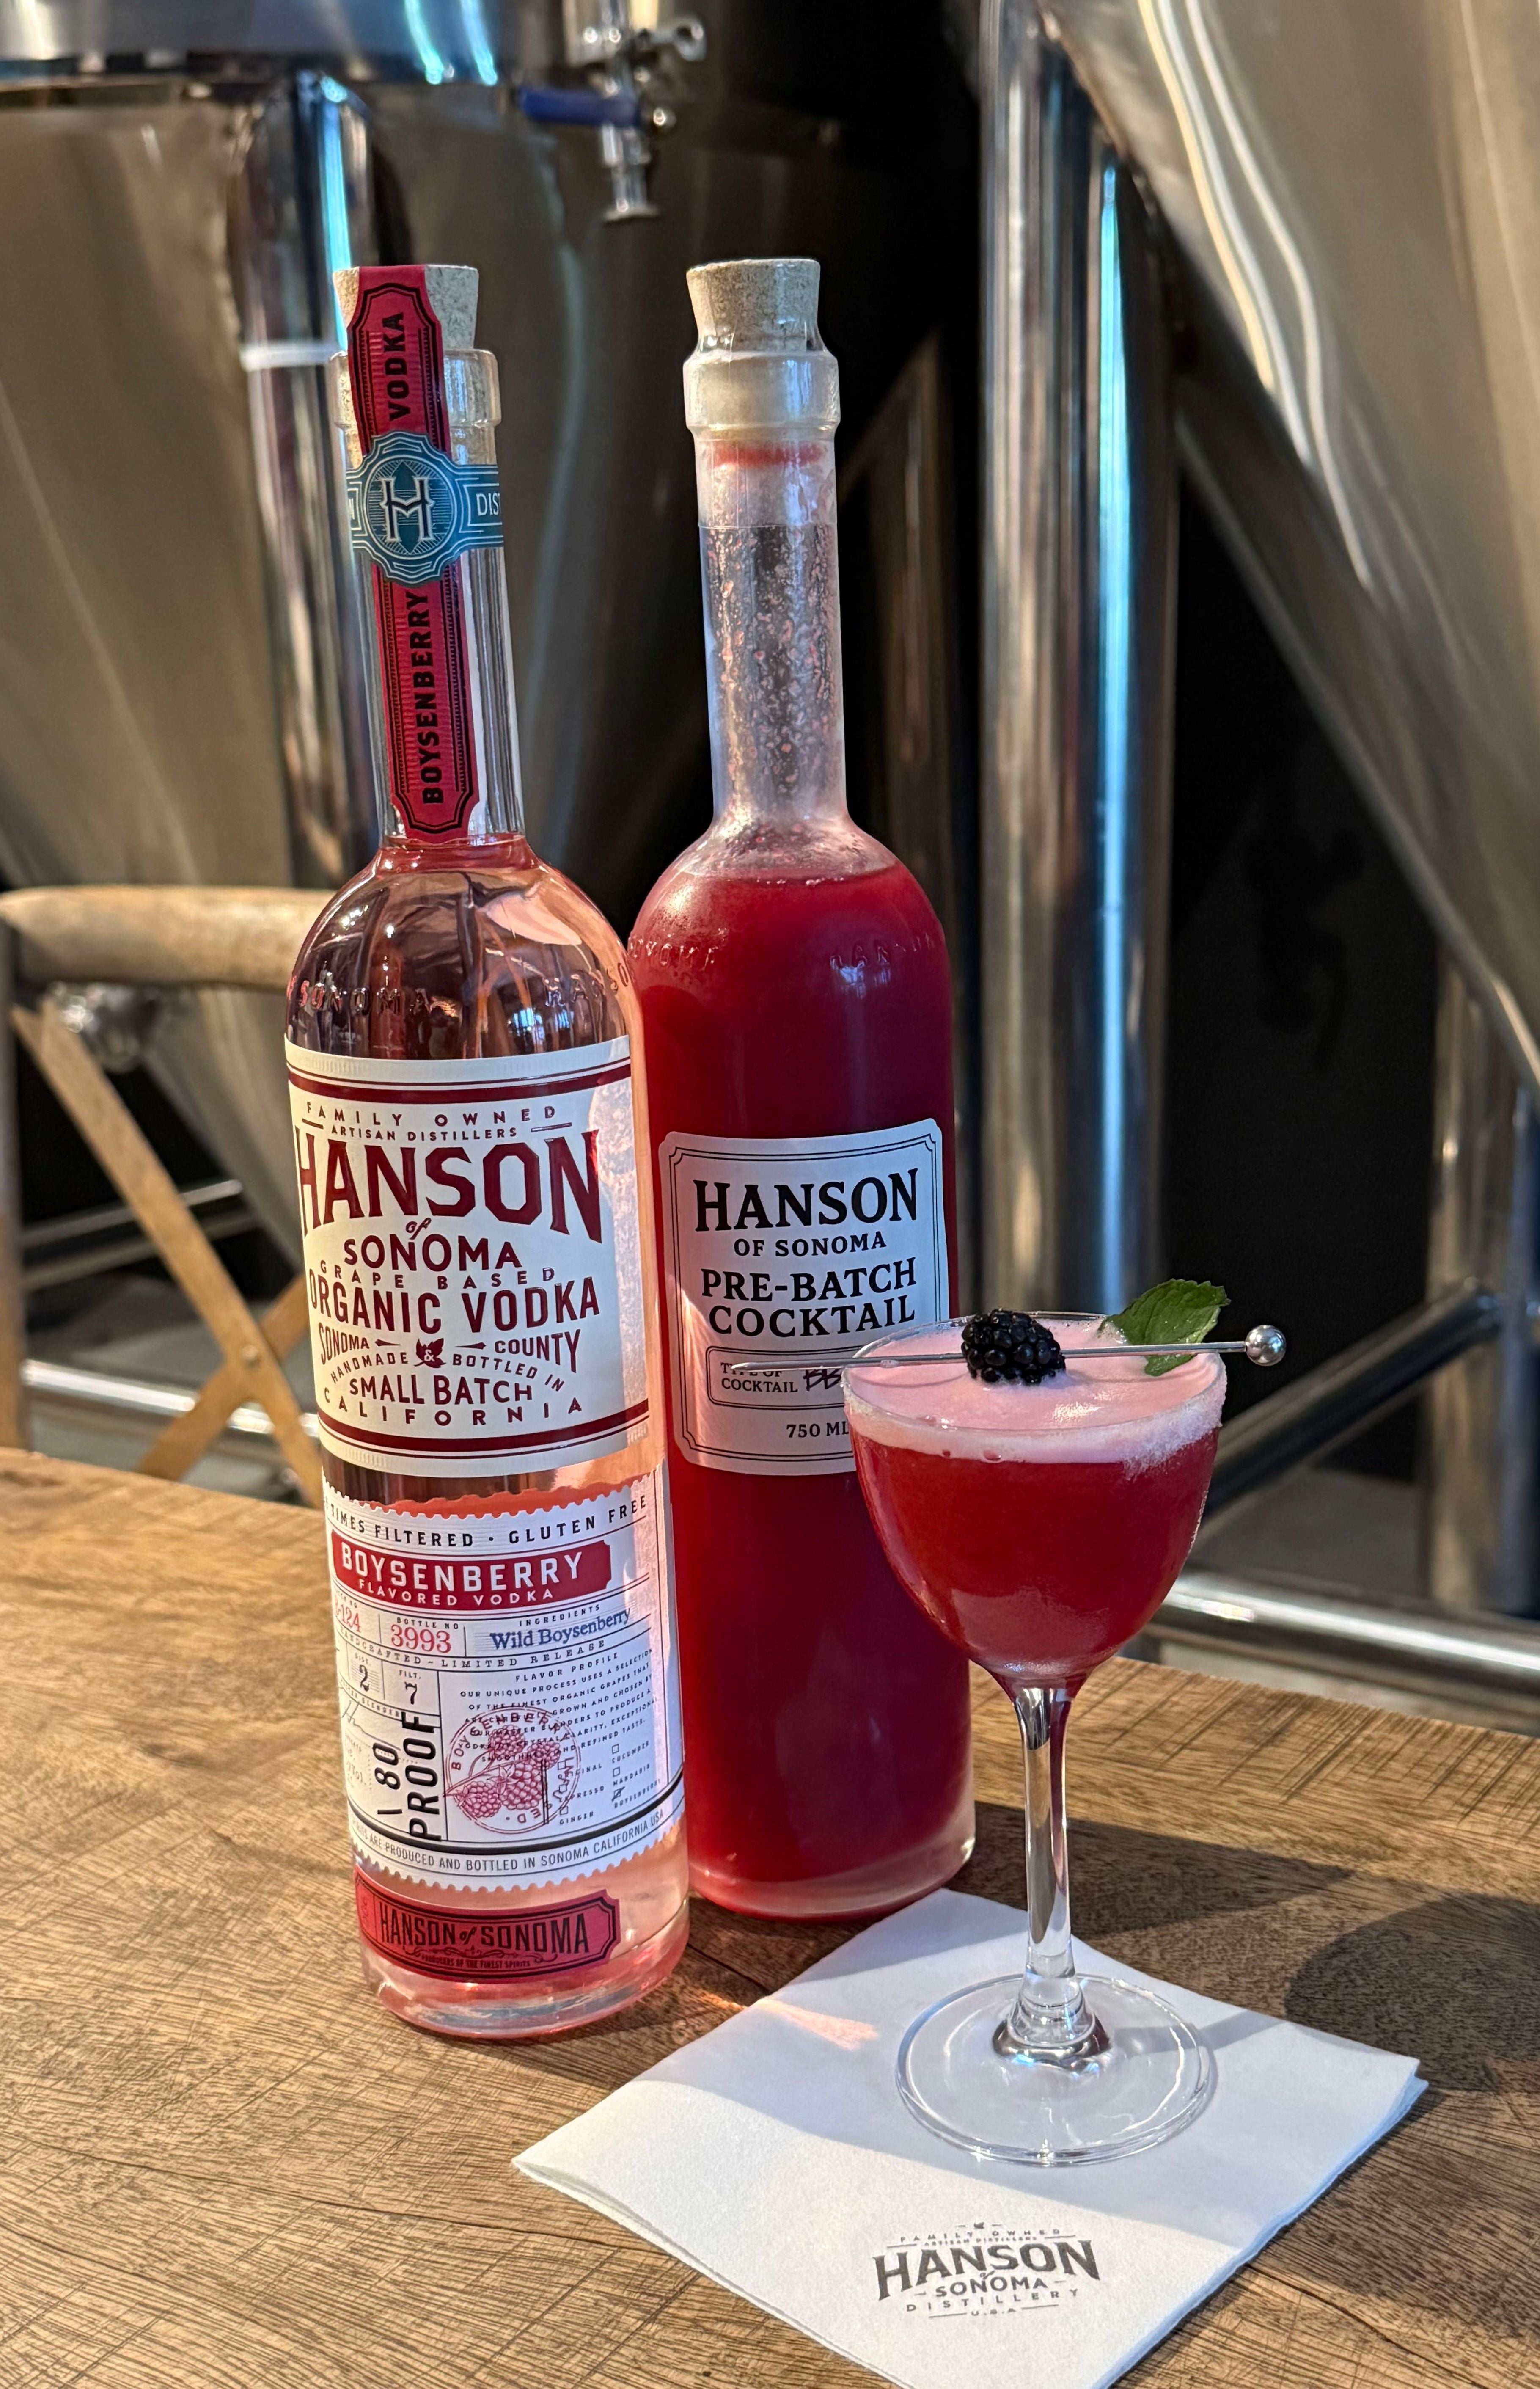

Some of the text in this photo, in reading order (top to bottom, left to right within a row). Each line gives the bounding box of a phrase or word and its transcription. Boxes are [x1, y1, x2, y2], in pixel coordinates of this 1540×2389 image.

[382, 312, 411, 422] VODKA
[476, 493, 500, 516] DIS
[406, 591, 444, 804] BOYSENBERRY
[307, 1102, 556, 1127] FAMILY OWNED
[331, 1125, 518, 1141] ARTISAN DISTILLERS
[295, 1126, 602, 1243] HANSON
[692, 1167, 918, 1232] HANSON
[406, 1217, 432, 1240] of
[344, 1234, 522, 1271] SONOMA
[734, 1231, 887, 1257] OF SONOMA
[320, 1259, 555, 1290] GRAPE BASED
[700, 1256, 917, 1302] PRE-BATCH
[309, 1268, 600, 1334] ORGANIC VODKA
[708, 1294, 916, 1338] COCKTAIL
[319, 1322, 581, 1373] SONOMA COUNTY
[331, 1352, 408, 1384] HANDMADE
[453, 1354, 538, 1379] BOTTLED
[544, 1374, 565, 1392] IN
[721, 1378, 798, 1393] COCKTAIL
[349, 1375, 533, 1405] SMALL BATCH
[324, 1387, 582, 1426] CALIFORNIA
[786, 1424, 821, 1438] 750
[331, 1495, 646, 1547] TIMES FILTERED GLUTEN FREE
[341, 1541, 582, 1592] BOYSENBERRY
[359, 1578, 457, 1606] FLAVORED
[473, 1591, 553, 1606] VODKA
[397, 1617, 437, 1628] BOTTLE
[490, 1607, 631, 1650] Wild Boysenberry
[519, 1604, 600, 1627] INGREDIENTS
[390, 1624, 452, 1653] 3993
[441, 1658, 517, 1668] LIMITED
[530, 1640, 605, 1664] RELEASE
[516, 1652, 618, 1682] FLAVOR PROFILE
[359, 1664, 370, 1692] 2
[404, 1681, 418, 1705] 7
[487, 1688, 526, 1697] UNIQUE
[532, 1679, 577, 1693] PROCESS
[581, 1672, 603, 1683] USES
[553, 1687, 596, 1703] ORGANIC
[600, 1673, 630, 1690] GRAPES
[553, 1703, 587, 1716] GROWN
[591, 1696, 609, 1706] AND
[401, 1711, 441, 1842] PROOF
[369, 1835, 383, 1849] ARE
[385, 1843, 434, 1866] PRODUCED
[439, 1858, 461, 1870] AND
[466, 1858, 518, 1871] BOTTLED
[524, 1857, 536, 1869] IN
[541, 1846, 589, 1866] SONOMA
[593, 1824, 649, 1853] CALIFORNIA
[651, 1809, 664, 1827] USA
[379, 1901, 456, 1946] HANSON
[459, 1926, 477, 1945] of
[481, 1913, 589, 1954] SONOMA
[900, 2229, 1060, 2243] FAMILY OWNED
[872, 2240, 1100, 2301] HANSON
[906, 2288, 1078, 2312] DISTILLERY
[935, 2276, 1048, 2297] SONOMA
